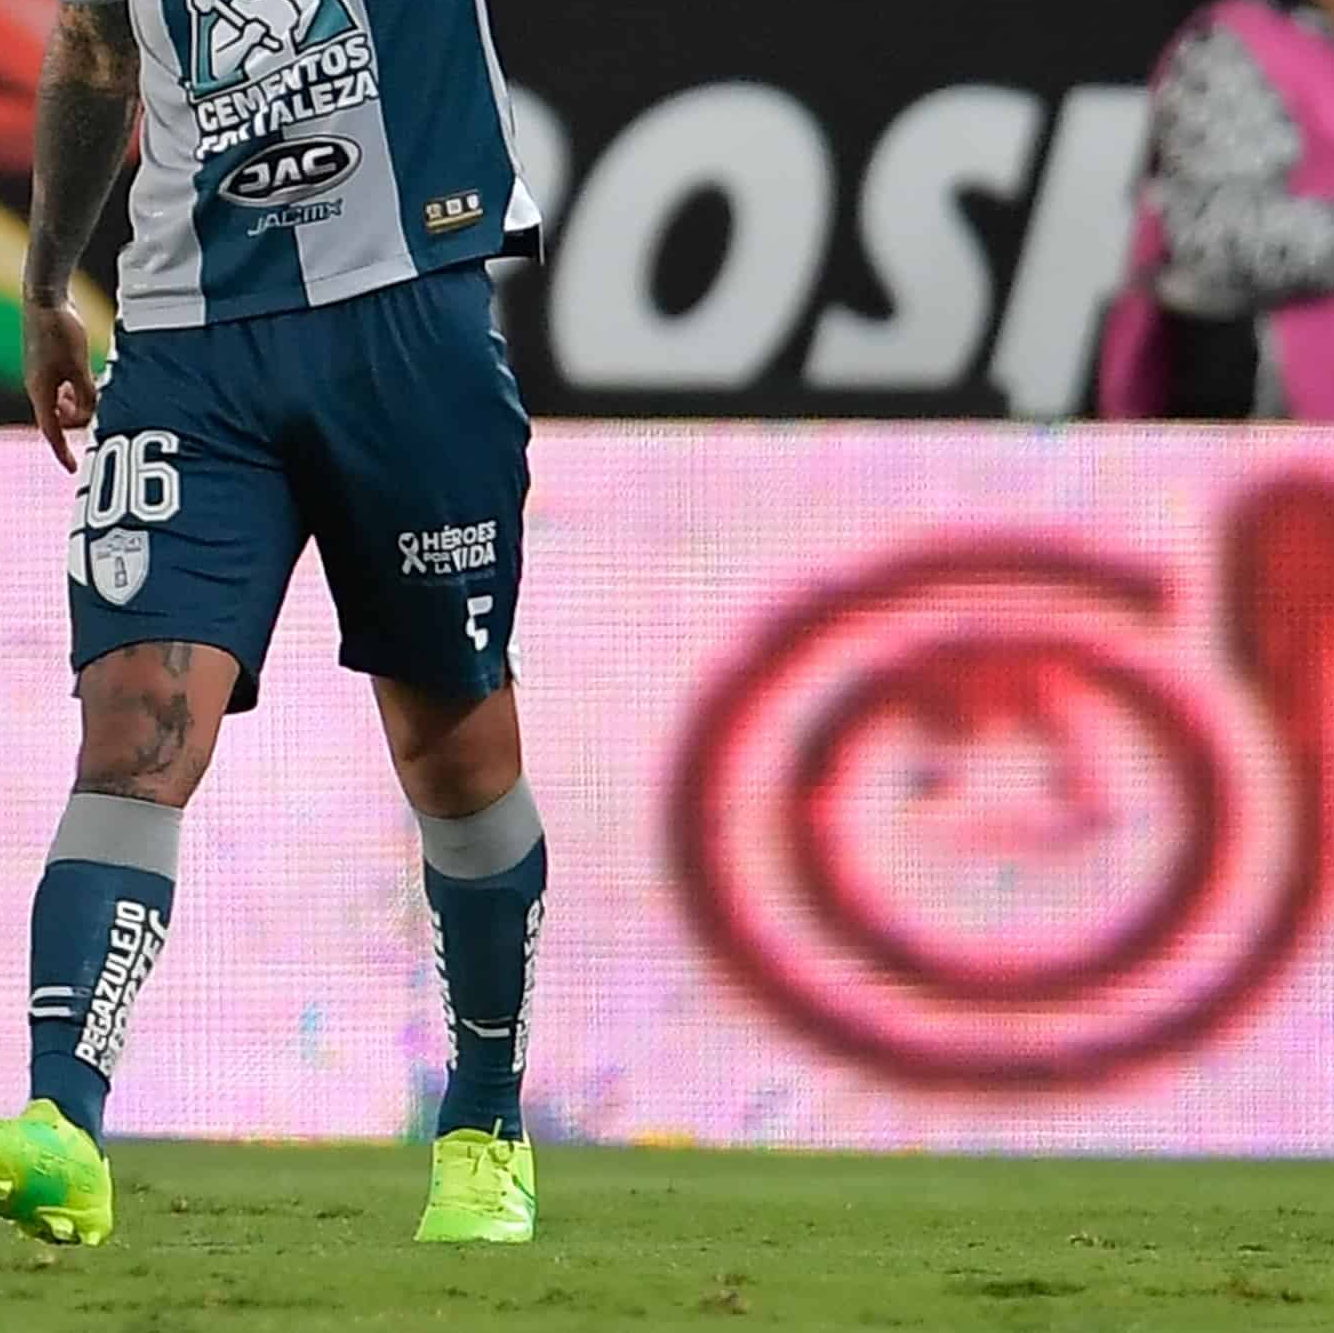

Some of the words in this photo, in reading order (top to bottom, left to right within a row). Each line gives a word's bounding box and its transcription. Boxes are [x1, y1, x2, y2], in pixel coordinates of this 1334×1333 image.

[197, 34, 371, 132] CEMENTOS
[238, 145, 337, 194] JAC
[451, 541, 497, 572] VIDA
[74, 899, 147, 1066] PEGAZULEJO
